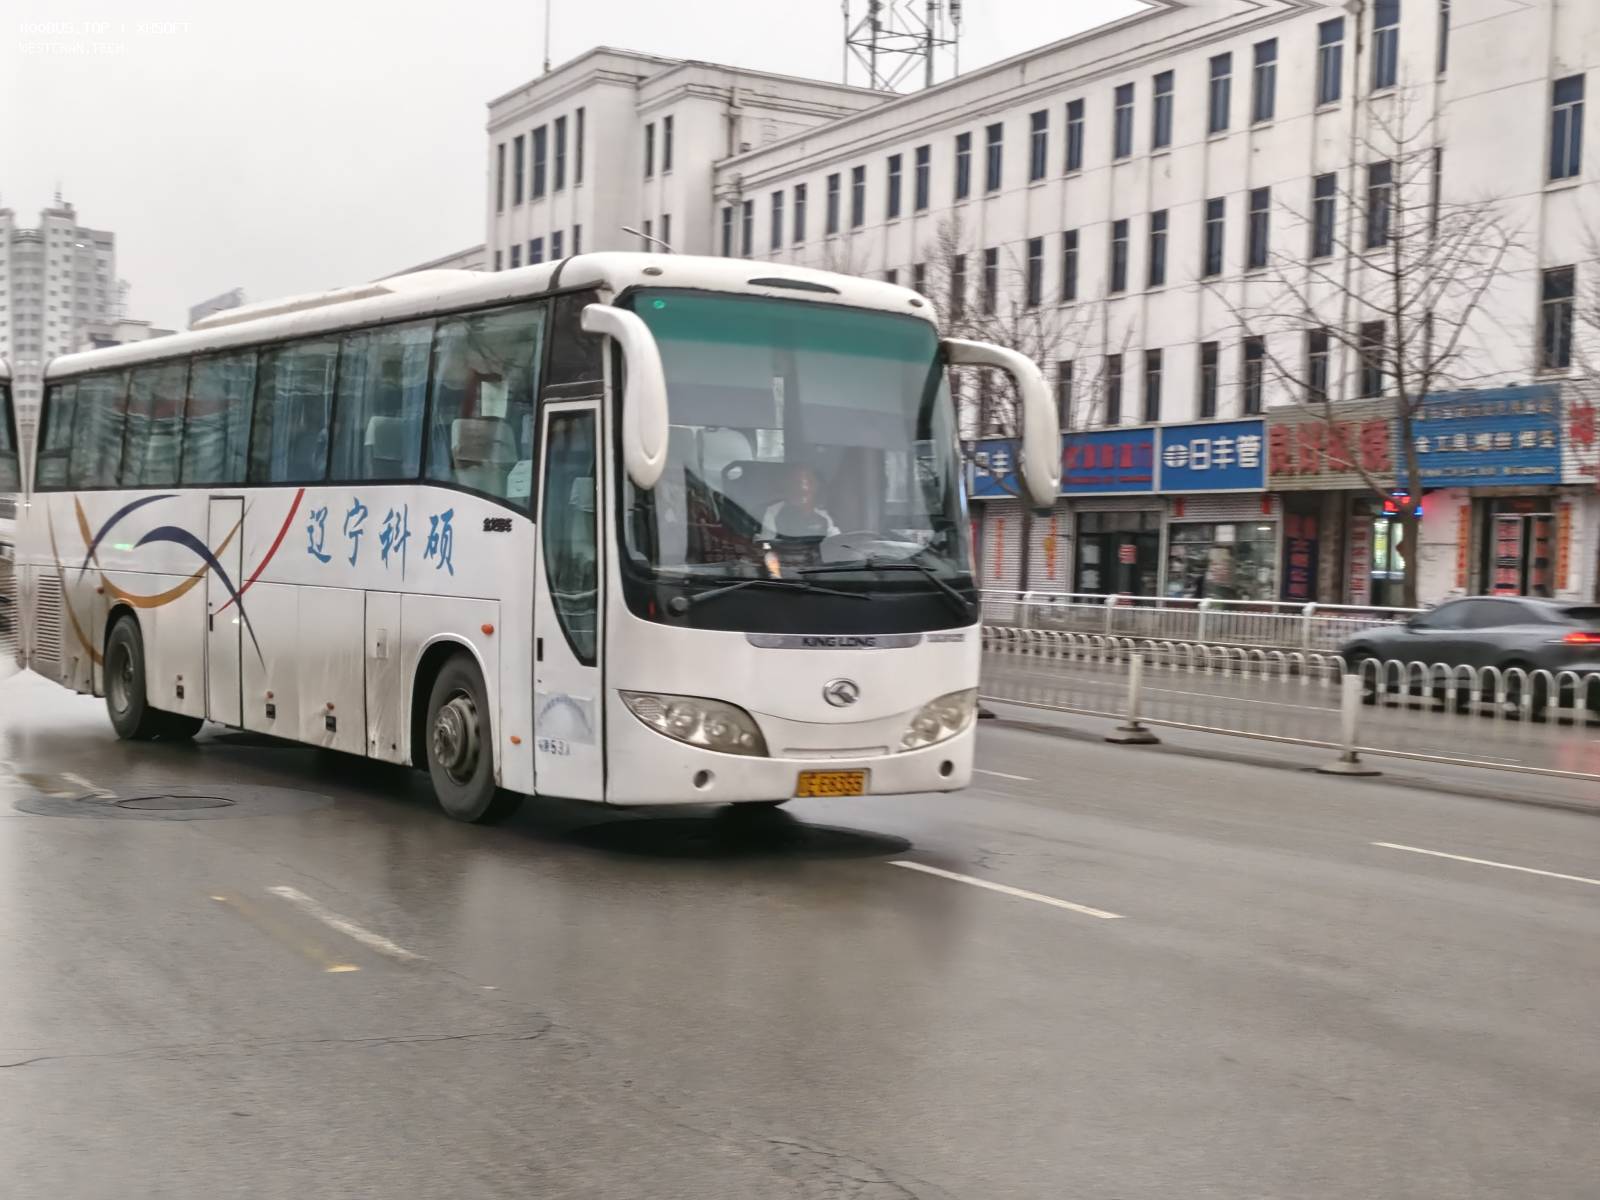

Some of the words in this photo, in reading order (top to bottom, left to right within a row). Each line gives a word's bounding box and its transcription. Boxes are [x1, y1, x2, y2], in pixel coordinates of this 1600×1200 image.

[1189, 435, 1261, 470] 日丰管
[307, 496, 456, 582] 辽宁科硕
[802, 637, 837, 647] KING
[841, 636, 876, 646] LONG
